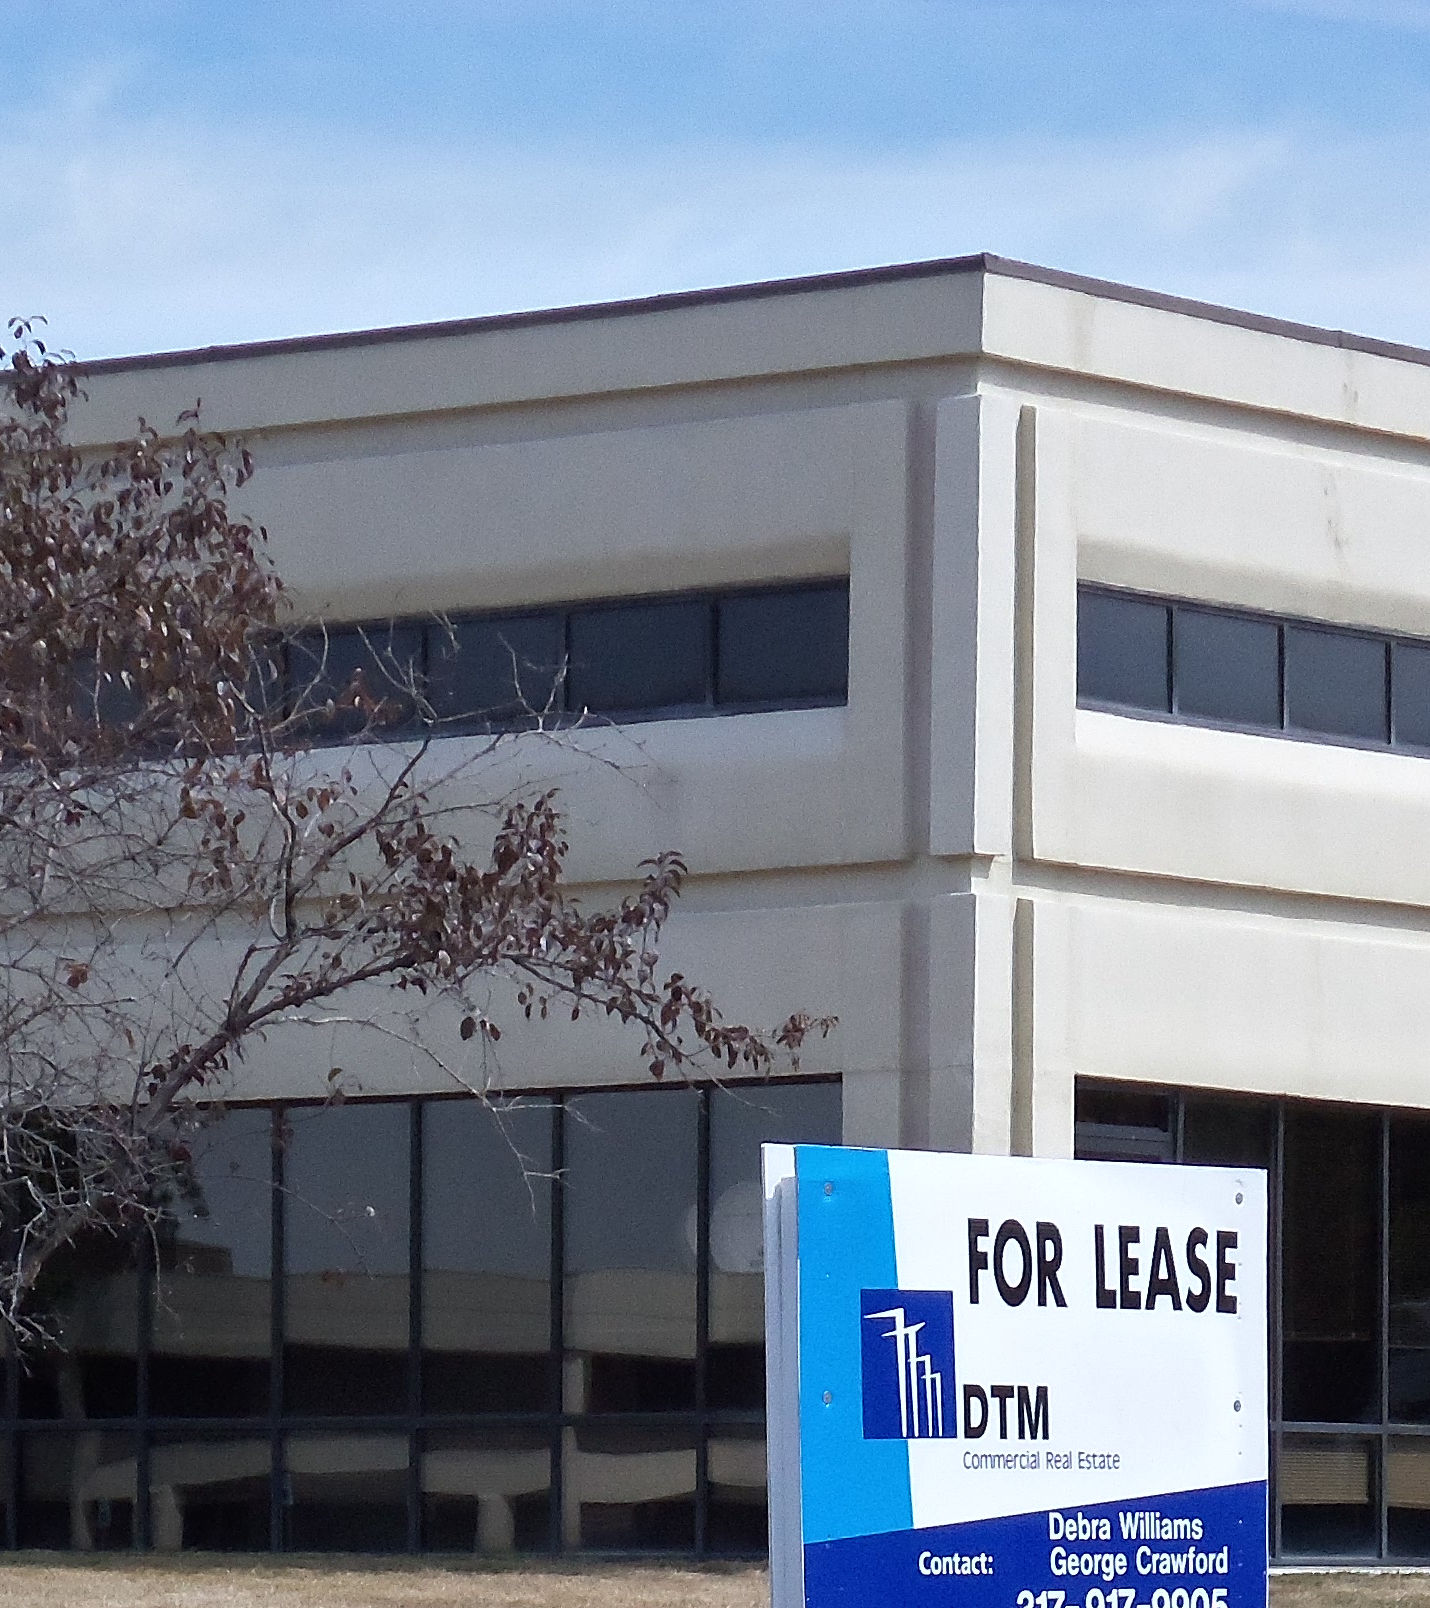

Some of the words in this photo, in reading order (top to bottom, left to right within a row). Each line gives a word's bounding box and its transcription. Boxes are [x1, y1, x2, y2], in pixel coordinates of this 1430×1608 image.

[968, 1217, 1068, 1308] FOR
[1094, 1224, 1238, 1314] LEASE
[963, 1384, 1050, 1440] DTM
[963, 1451, 1040, 1470] Commercial
[1046, 1451, 1073, 1470] Real
[1078, 1452, 1120, 1470] Estate
[1048, 1511, 1111, 1540] Debra
[1119, 1511, 1203, 1539] Williams
[919, 1551, 993, 1575] Contact:
[1050, 1547, 1127, 1581] George
[1136, 1546, 1228, 1574] Crawford
